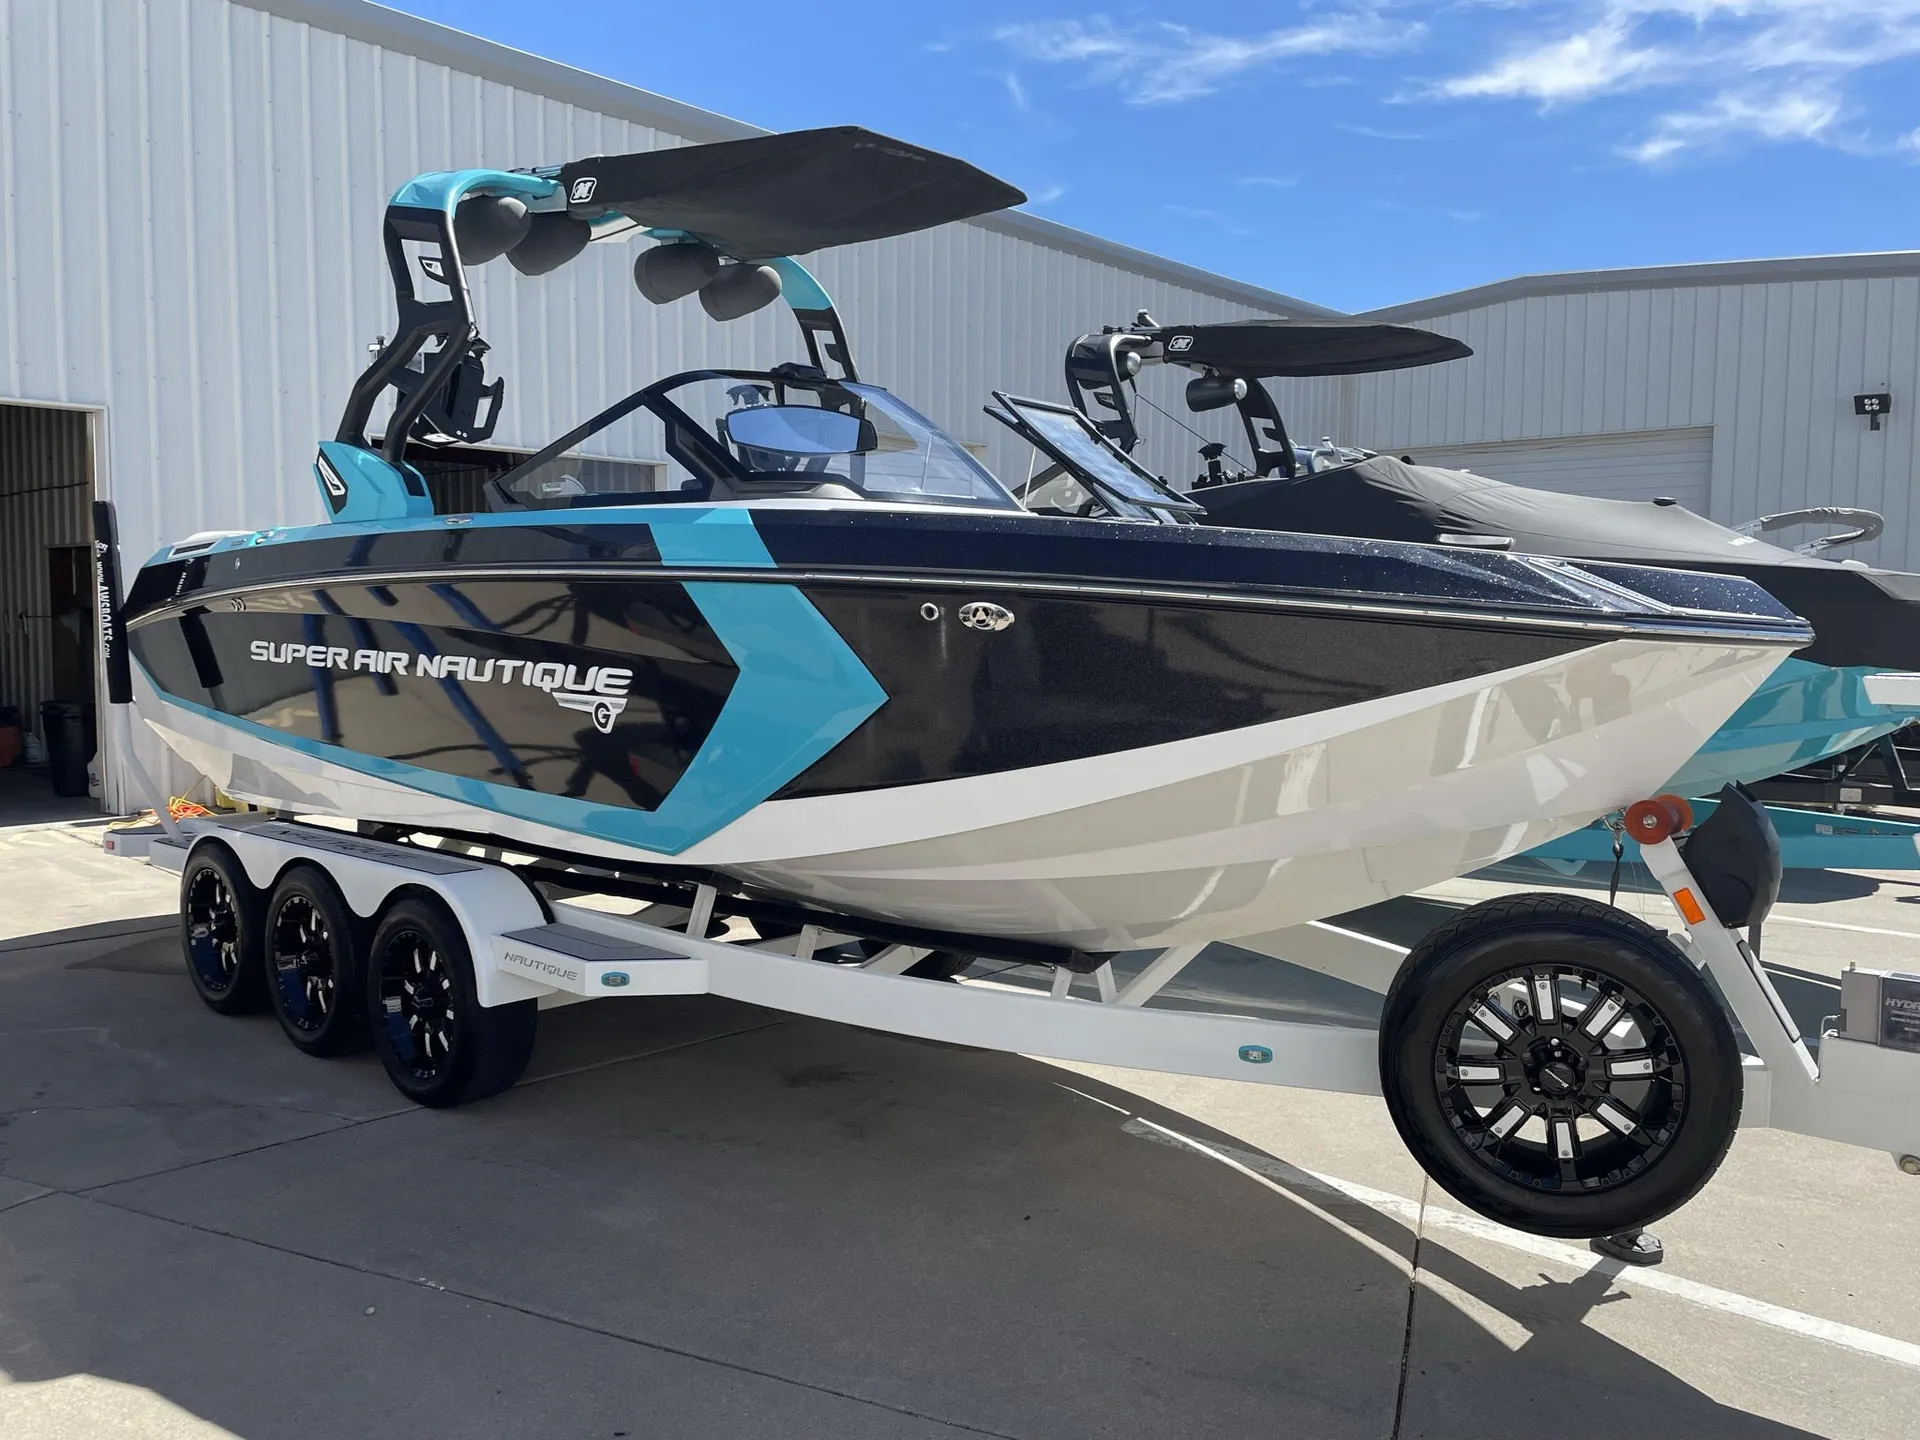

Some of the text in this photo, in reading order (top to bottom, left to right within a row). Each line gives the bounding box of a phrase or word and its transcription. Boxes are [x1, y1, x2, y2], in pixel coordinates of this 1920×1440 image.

[250, 640, 634, 695] SUPER AIR NAUTIQUE
[504, 952, 578, 981] NAUTIQUE
